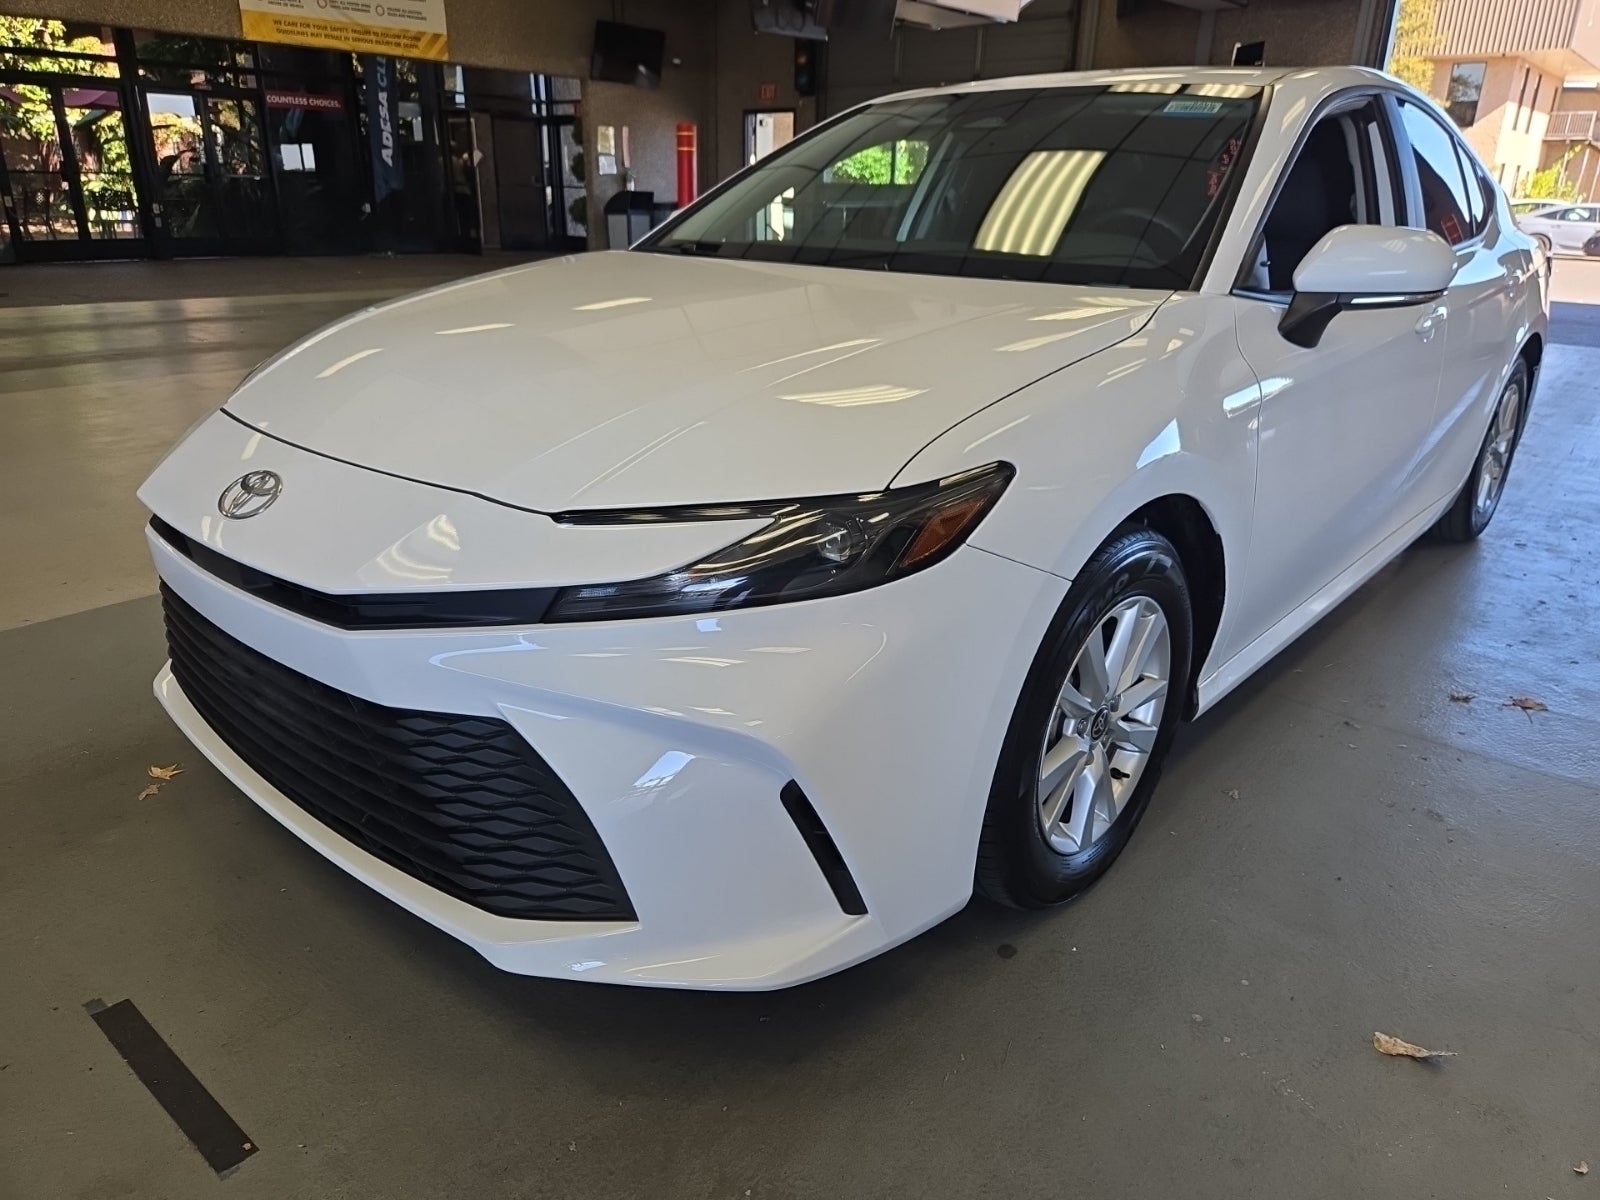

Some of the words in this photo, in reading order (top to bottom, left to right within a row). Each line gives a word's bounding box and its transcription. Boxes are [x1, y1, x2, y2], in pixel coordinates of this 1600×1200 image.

[283, 20, 298, 28] CARE
[312, 23, 328, 31] YOUR
[266, 95, 307, 106] COUNTLESS
[378, 91, 393, 167] ADESA
